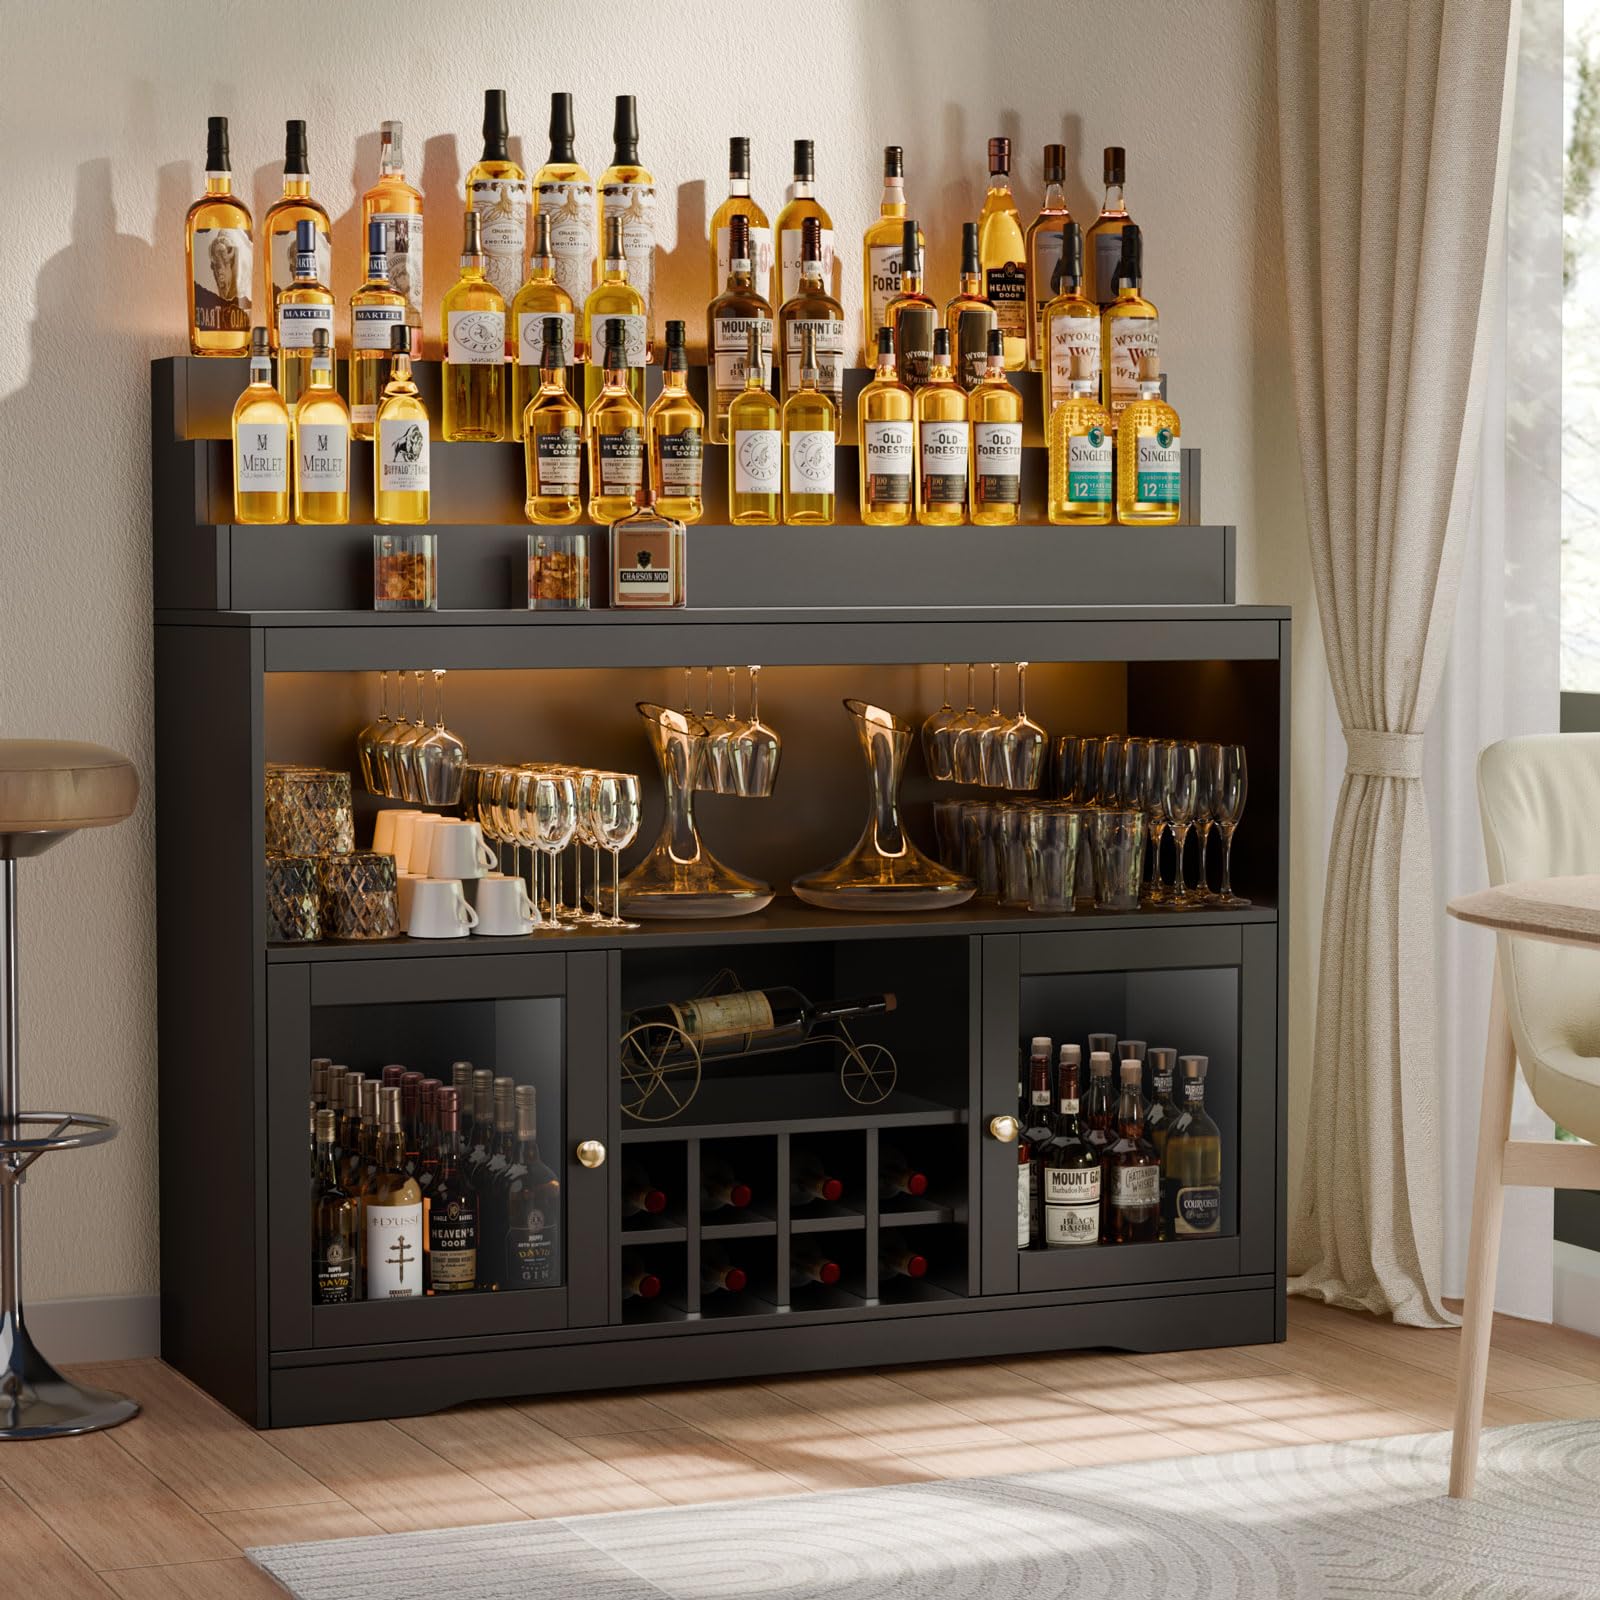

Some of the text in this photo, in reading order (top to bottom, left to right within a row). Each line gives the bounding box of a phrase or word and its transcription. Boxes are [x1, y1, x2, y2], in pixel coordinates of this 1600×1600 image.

[872, 276, 901, 292] FORE
[285, 311, 329, 319] MARTELL
[357, 312, 400, 320] MARTELL
[794, 322, 831, 334] MOUNT
[722, 333, 748, 341] Barbado
[1056, 332, 1099, 345] WYOMI
[1115, 334, 1159, 346] WYOMIN
[883, 433, 902, 444] OLD
[939, 433, 958, 444] OLD
[993, 434, 1012, 445] OLD
[243, 454, 282, 472] MERLET
[303, 455, 343, 472] MERLET
[384, 464, 409, 475] BUFFALO
[1074, 483, 1089, 497] 12
[1143, 483, 1158, 497] 12
[653, 572, 668, 581] NOD
[1052, 1172, 1089, 1185] MOUNT
[1052, 1185, 1078, 1194] Barbados
[1063, 1216, 1095, 1225] BLACK
[432, 1228, 474, 1239] HEAVEN'S
[319, 1279, 349, 1288] DAVID
